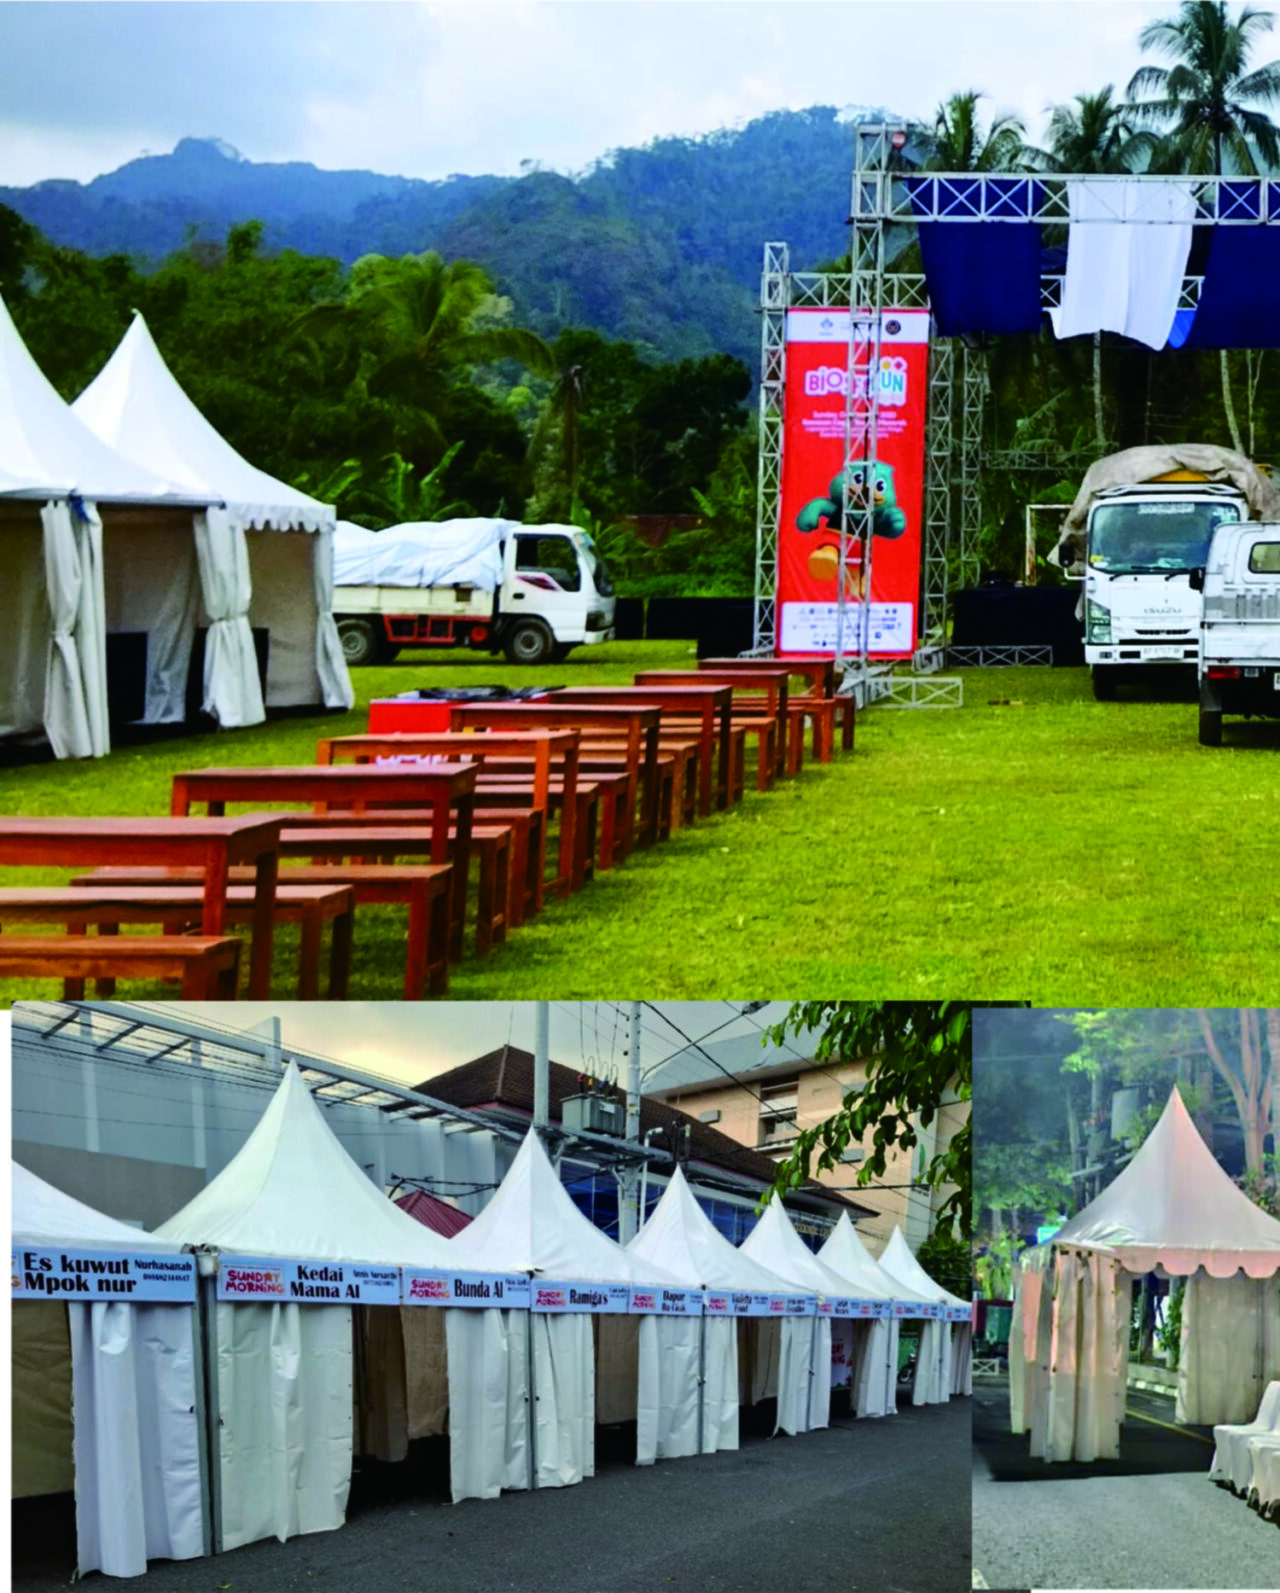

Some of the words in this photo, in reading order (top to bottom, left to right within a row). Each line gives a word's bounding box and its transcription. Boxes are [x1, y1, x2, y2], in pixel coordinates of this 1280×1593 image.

[24, 1252, 53, 1271] Es
[60, 1254, 130, 1275] kuwut
[134, 1258, 193, 1272] Nurhasanah
[227, 1269, 281, 1283] SUNDAY
[297, 1265, 344, 1282] Kedai
[24, 1272, 91, 1295] Mpok
[97, 1278, 138, 1293] nur
[290, 1281, 341, 1298] Mama
[454, 1279, 490, 1298] Bunda
